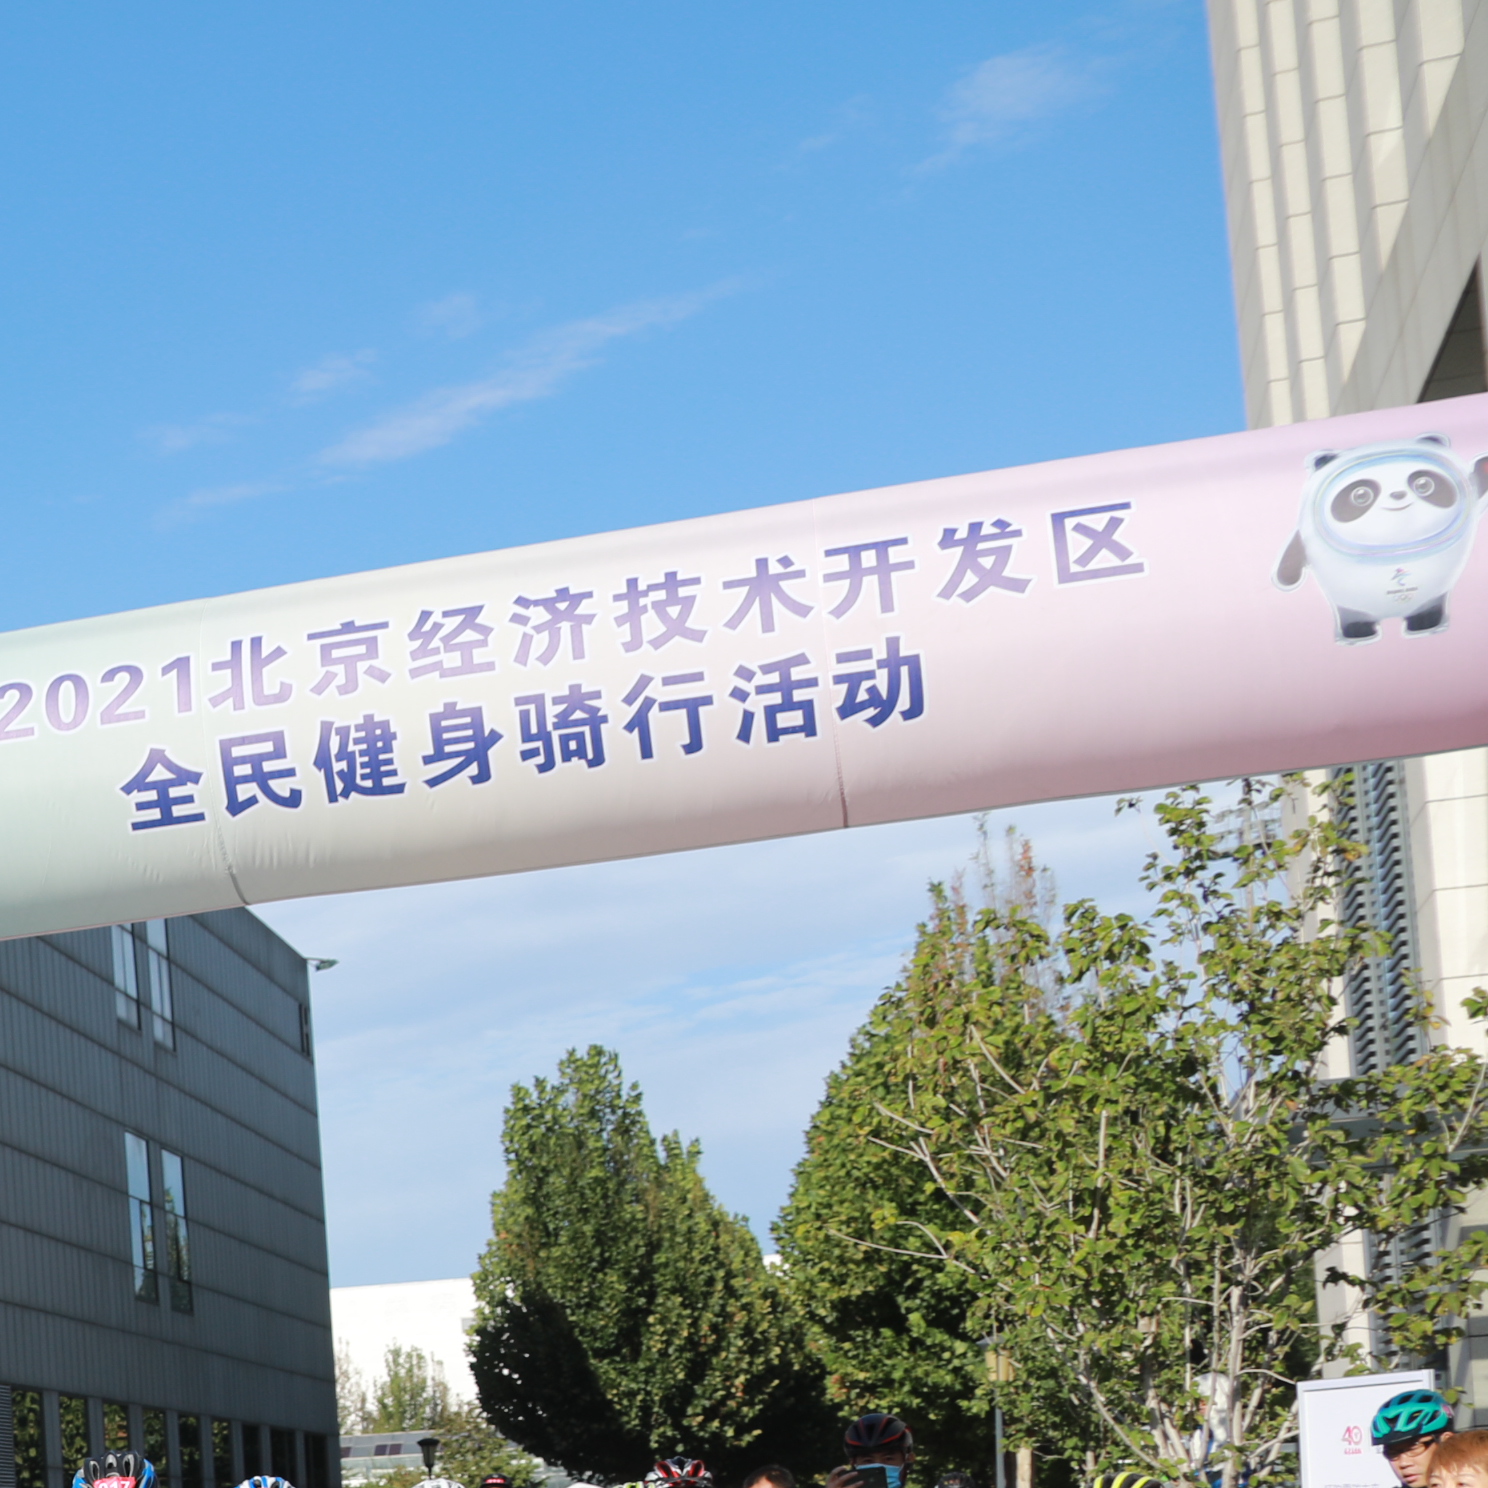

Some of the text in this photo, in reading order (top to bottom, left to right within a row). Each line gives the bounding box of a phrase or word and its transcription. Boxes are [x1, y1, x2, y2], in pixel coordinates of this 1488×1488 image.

[120, 636, 927, 832] 全民健身骑行活动
